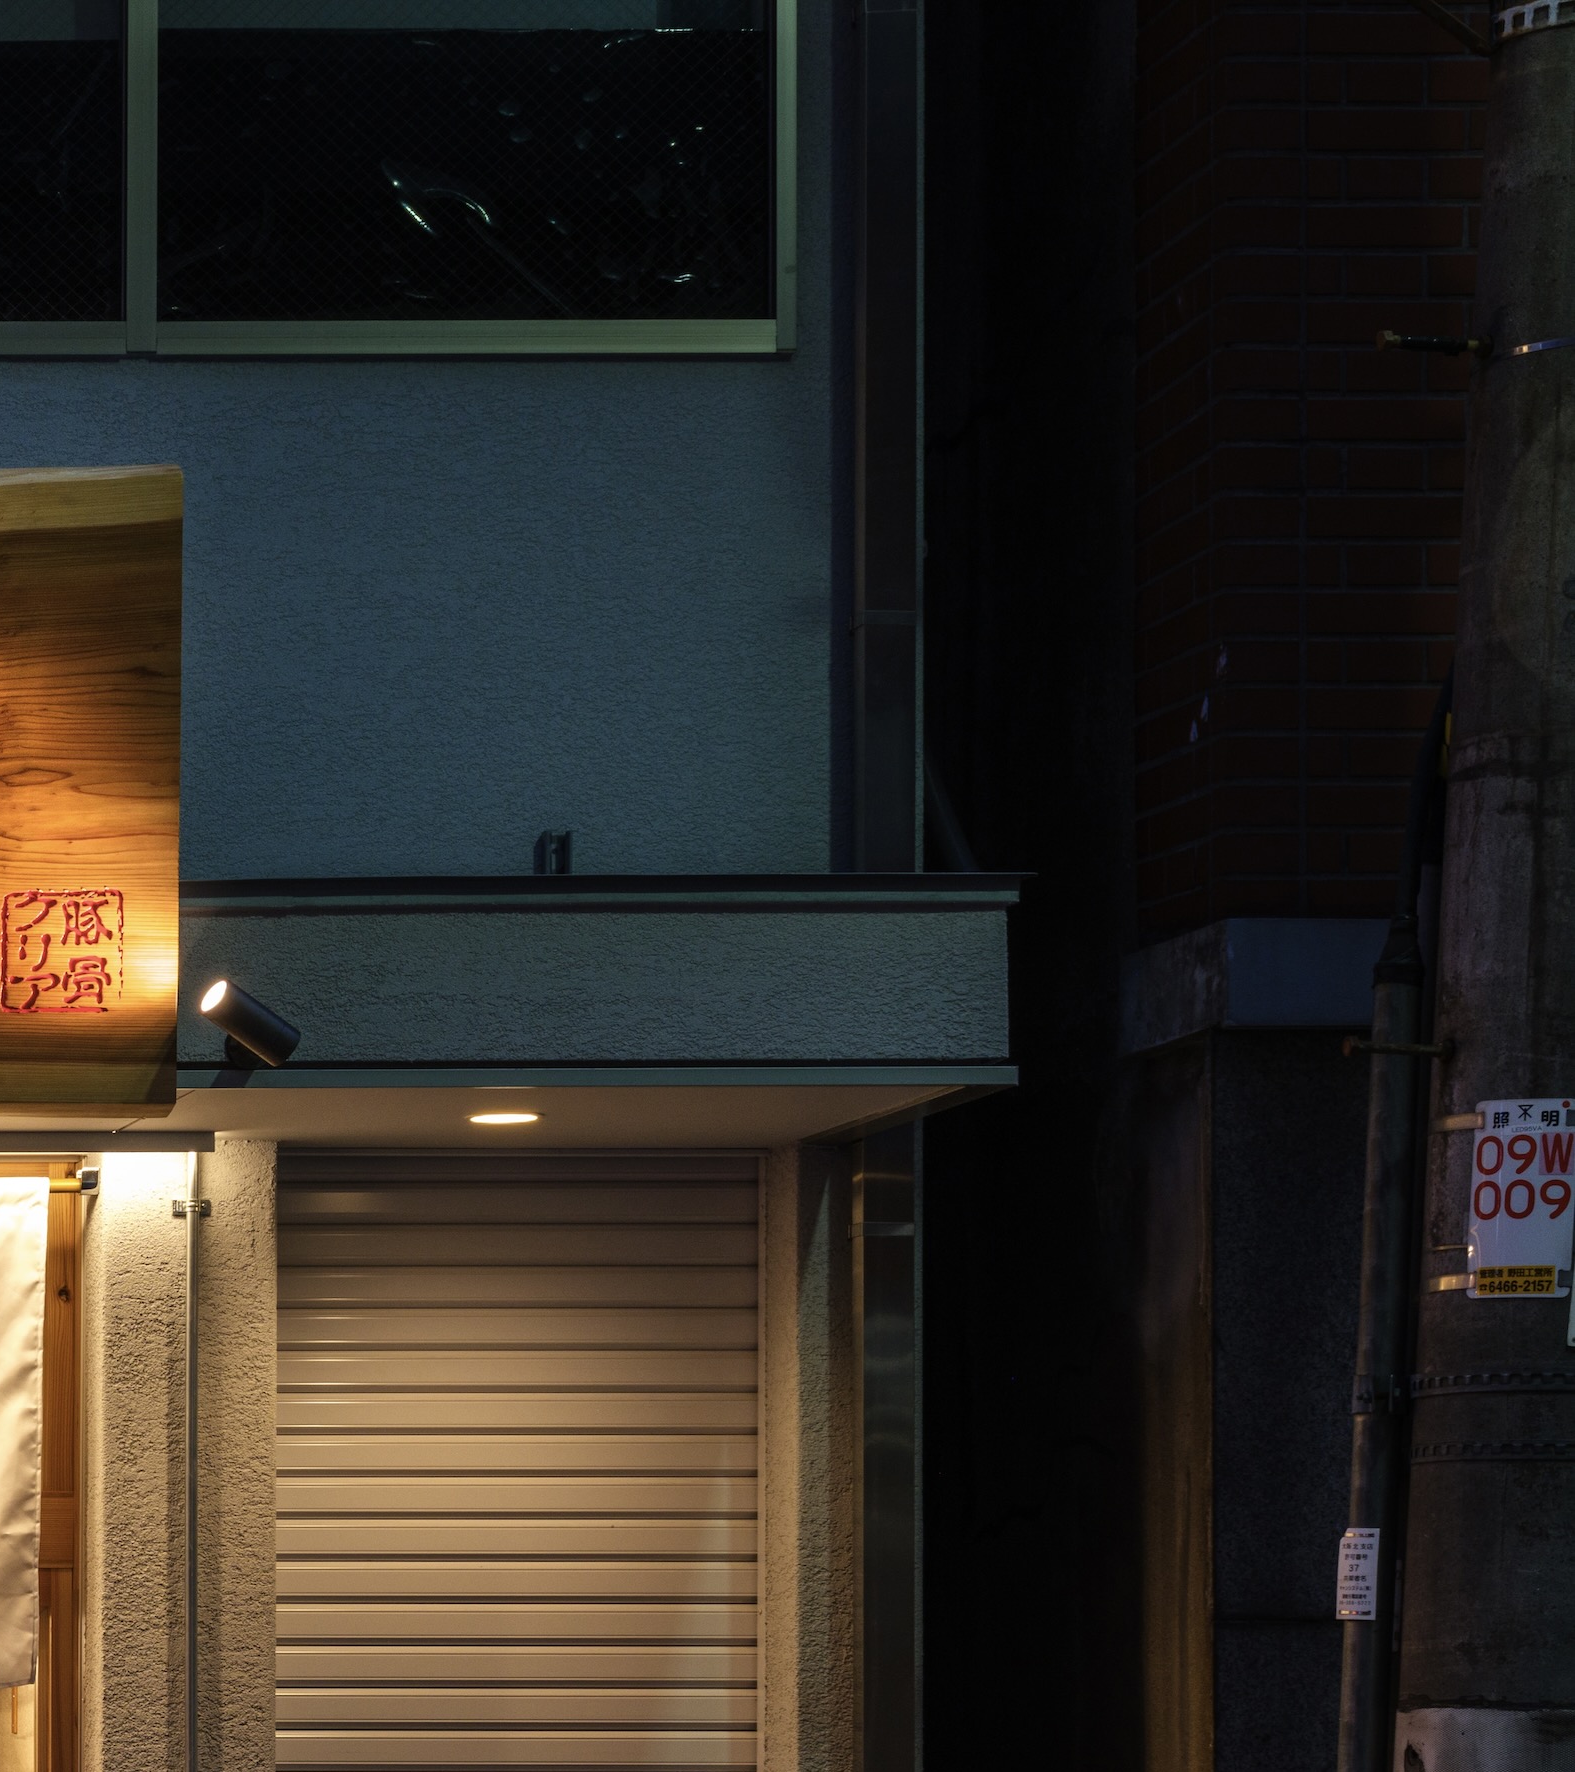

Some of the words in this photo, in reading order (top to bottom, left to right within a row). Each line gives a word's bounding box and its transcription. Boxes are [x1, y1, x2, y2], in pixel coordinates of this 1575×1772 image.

[1476, 1132, 1575, 1175] 09W
[1473, 1179, 1571, 1220] 009
[1507, 1267, 1553, 1278] 野田工営所
